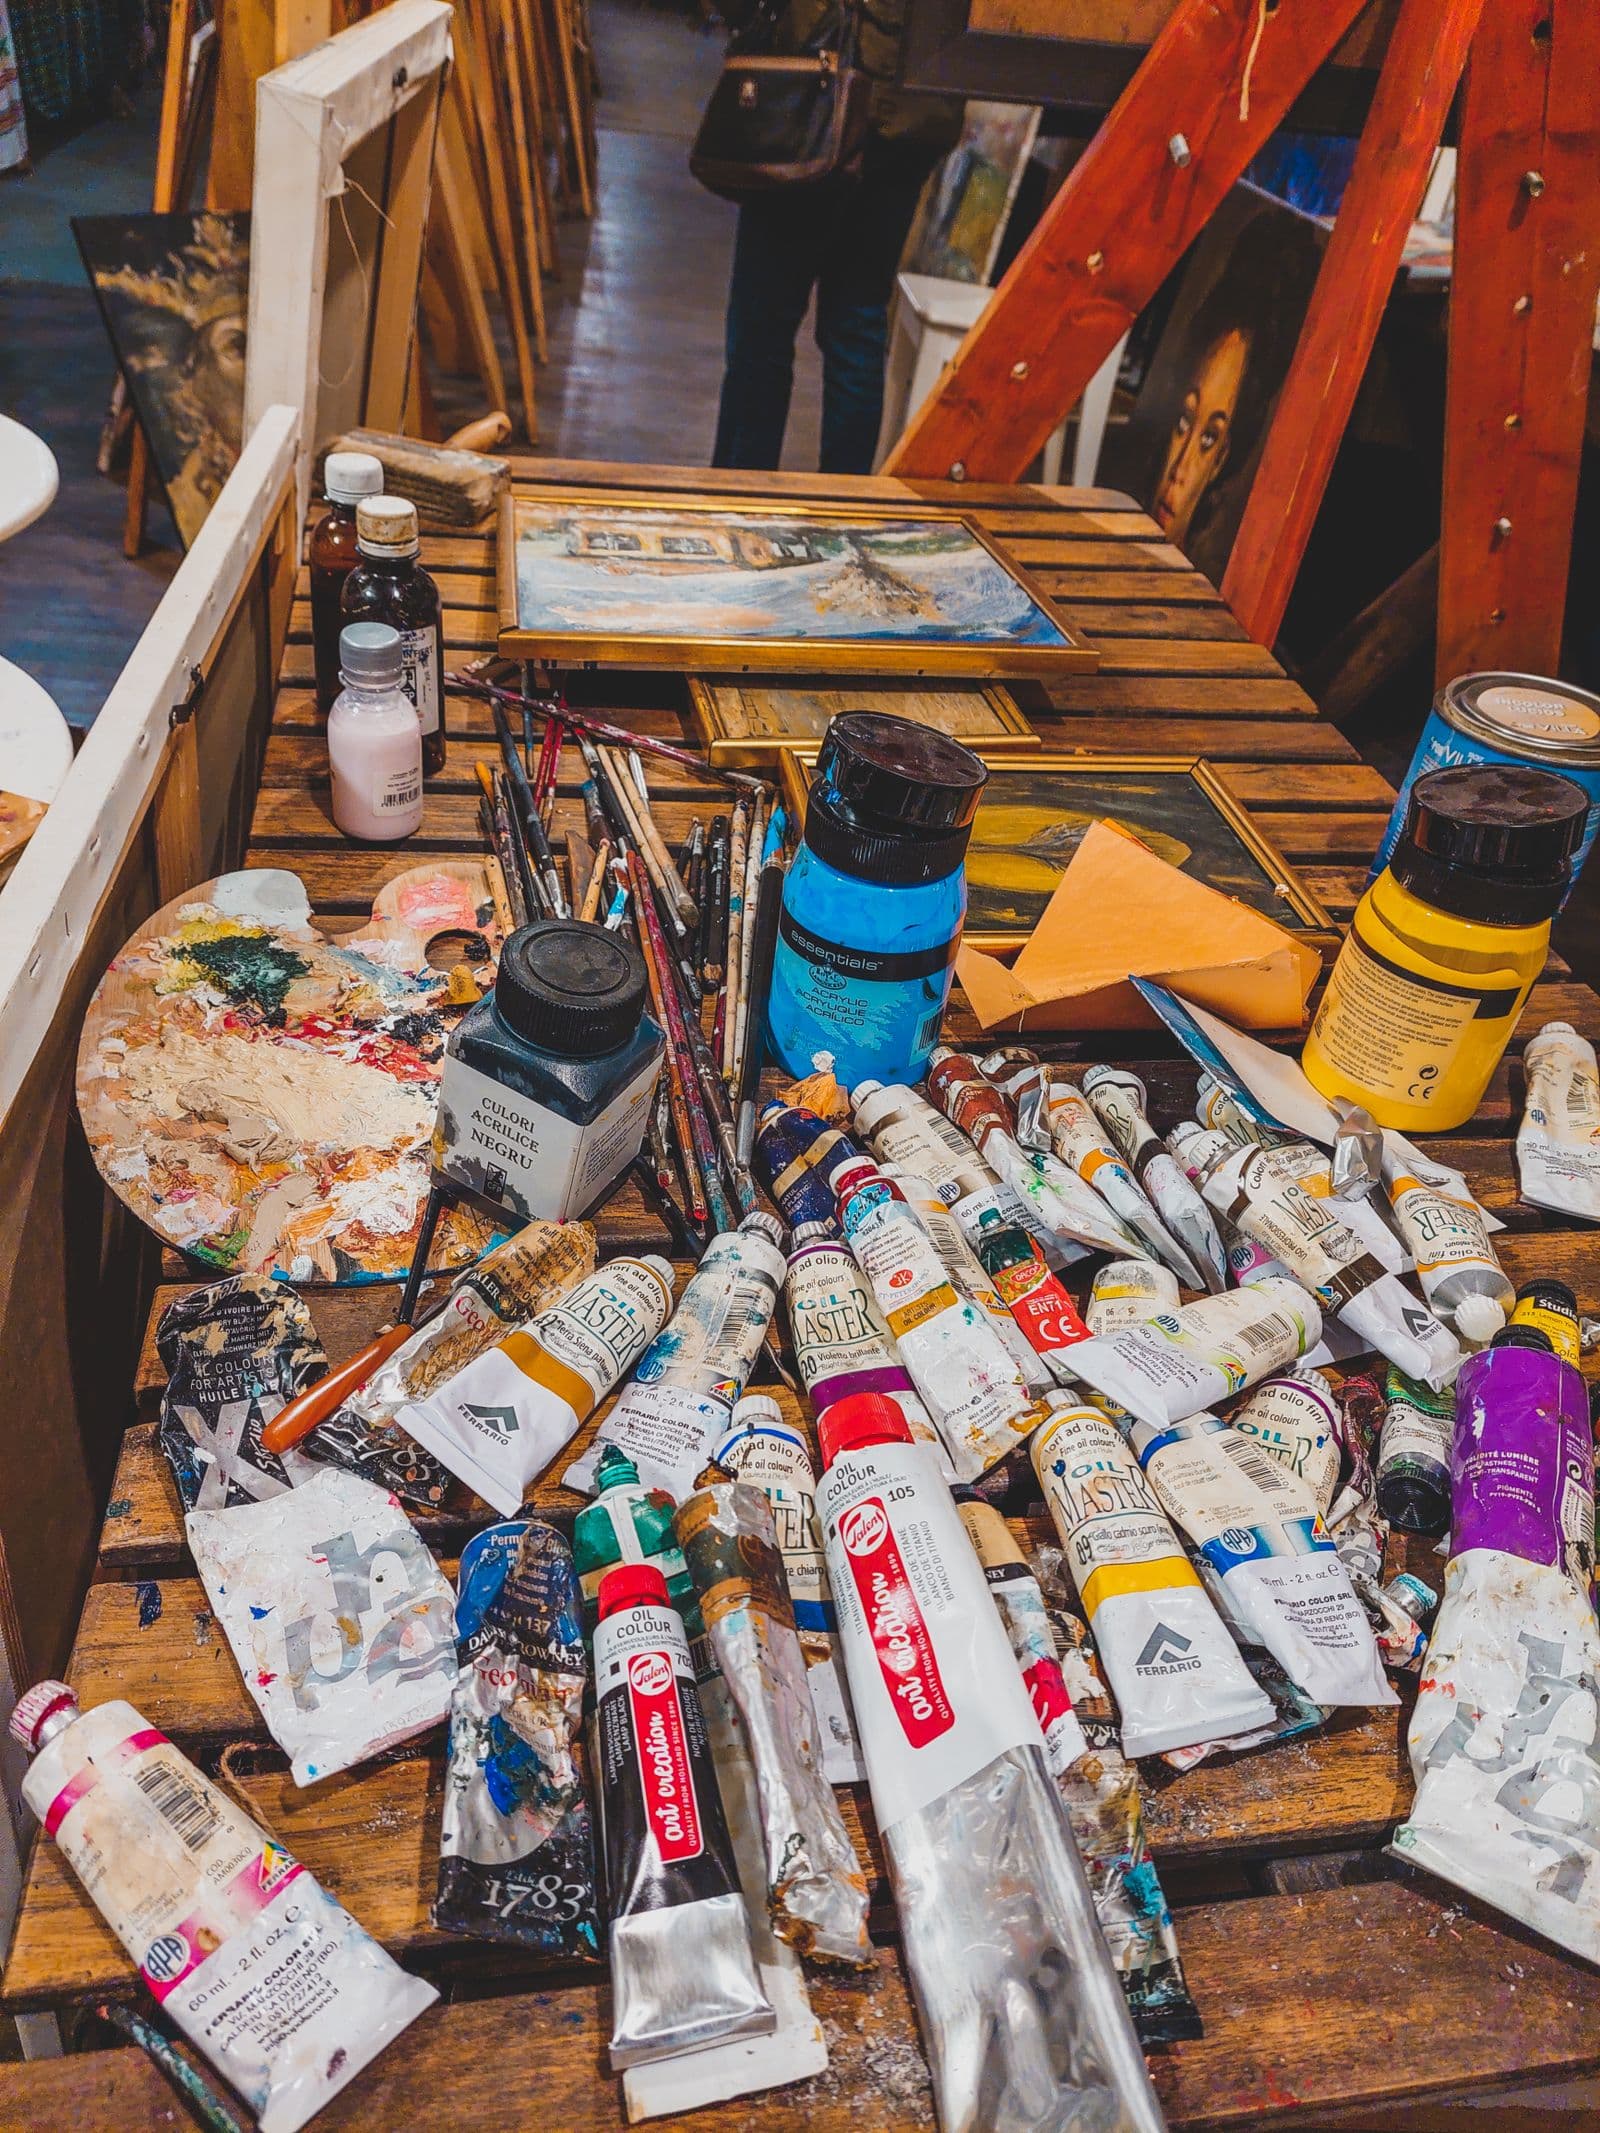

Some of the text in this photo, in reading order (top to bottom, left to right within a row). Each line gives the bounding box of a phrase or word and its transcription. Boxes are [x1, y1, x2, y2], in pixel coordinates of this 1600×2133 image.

[796, 987, 867, 1017] ACRYLIQUE
[812, 986, 868, 1008] ACRYLIC
[806, 1003, 865, 1026] ACRÍLICO
[482, 1097, 535, 1134] CULORI
[470, 1109, 540, 1153] ACRILICE
[470, 1127, 534, 1170] NEGRU
[1249, 1160, 1268, 1190] Colori
[937, 1184, 958, 1201] APA
[539, 1225, 557, 1244] Buff
[1257, 1213, 1308, 1262] USO PROFESSIONALE
[799, 1254, 839, 1272] ad olio
[1428, 1249, 1472, 1262] olio fini
[632, 1267, 648, 1283] ad
[647, 1283, 662, 1304] olio
[818, 1274, 845, 1288] colours
[613, 1273, 656, 1314] Fine oil colours
[797, 1294, 847, 1310] OIL
[599, 1288, 637, 1325] OIL
[1028, 1301, 1062, 1316] EN71
[555, 1283, 648, 1369] MASTER
[1039, 1316, 1081, 1342] CE
[1140, 1328, 1153, 1341] 60
[1157, 1314, 1181, 1335] APA
[557, 1319, 614, 1383] Terra Siena naturale
[817, 1352, 848, 1361] Violetto
[849, 1346, 881, 1360] brillante
[214, 1354, 273, 1376] COLOUR
[190, 1367, 276, 1391] FOR ARTISTS
[199, 1389, 240, 1403] HUILE
[631, 1389, 643, 1398] 60
[620, 1407, 660, 1422] FERRARIO
[661, 1418, 690, 1430] COLOR
[1256, 1408, 1300, 1427] oil colours
[1259, 1389, 1326, 1425] ad olio fini
[456, 1402, 511, 1446] FERRARIO
[641, 1421, 683, 1437] MARZOCCHI
[1065, 1422, 1110, 1439] ad olio
[1236, 1422, 1290, 1446] OIL
[664, 1433, 685, 1447] RENO
[749, 1438, 793, 1459] ad olio
[1060, 1435, 1116, 1457] Fine oil colours
[755, 1460, 766, 1471] oil
[767, 1461, 794, 1475] colours
[836, 1462, 857, 1480] OIL
[1071, 1460, 1124, 1479] OIL
[1154, 1459, 1165, 1471] 26
[1500, 1452, 1540, 1467] LUMIÈRE
[827, 1465, 878, 1502] COLOUR
[887, 1485, 916, 1503] 105
[1496, 1484, 1534, 1498] PIGMENTS
[1051, 1463, 1162, 1533] MASTER
[908, 1522, 932, 1573] DE TITANIO
[1222, 1528, 1254, 1551] APA
[797, 1563, 824, 1577] chiaro
[886, 1552, 901, 1576] 1899
[897, 1527, 932, 1608] BLANC DE TITANE
[919, 1520, 955, 1601] BIANCO DI TITANIO
[1308, 1595, 1336, 1606] COLOR
[1337, 1592, 1353, 1601] SRL
[526, 1615, 551, 1636] 137
[632, 1610, 655, 1622] OIL
[1325, 1613, 1344, 1624] RENO
[616, 1622, 673, 1639] COLOUR
[871, 1571, 934, 1721] art creation
[920, 1653, 935, 1677] FROM
[1136, 1659, 1202, 1677] FERRARIO
[682, 1686, 694, 1724] BOUGIE
[927, 1677, 950, 1719] QUALITY
[617, 1694, 633, 1753] LAMP BLACK
[688, 1723, 697, 1737] DE
[693, 1738, 703, 1759] NOIR
[645, 1710, 686, 1842] art creation
[667, 1700, 698, 1848] QUALITY FROM HOLLAND SINCE 1899
[480, 1874, 586, 1921] 1783
[143, 1935, 188, 1980] APA
[263, 1948, 302, 1987] COLOR
[288, 1961, 319, 1993] RENO
[317, 1940, 339, 1967] (BO)
[188, 1927, 289, 2013] 60 ml. fl. oz.
